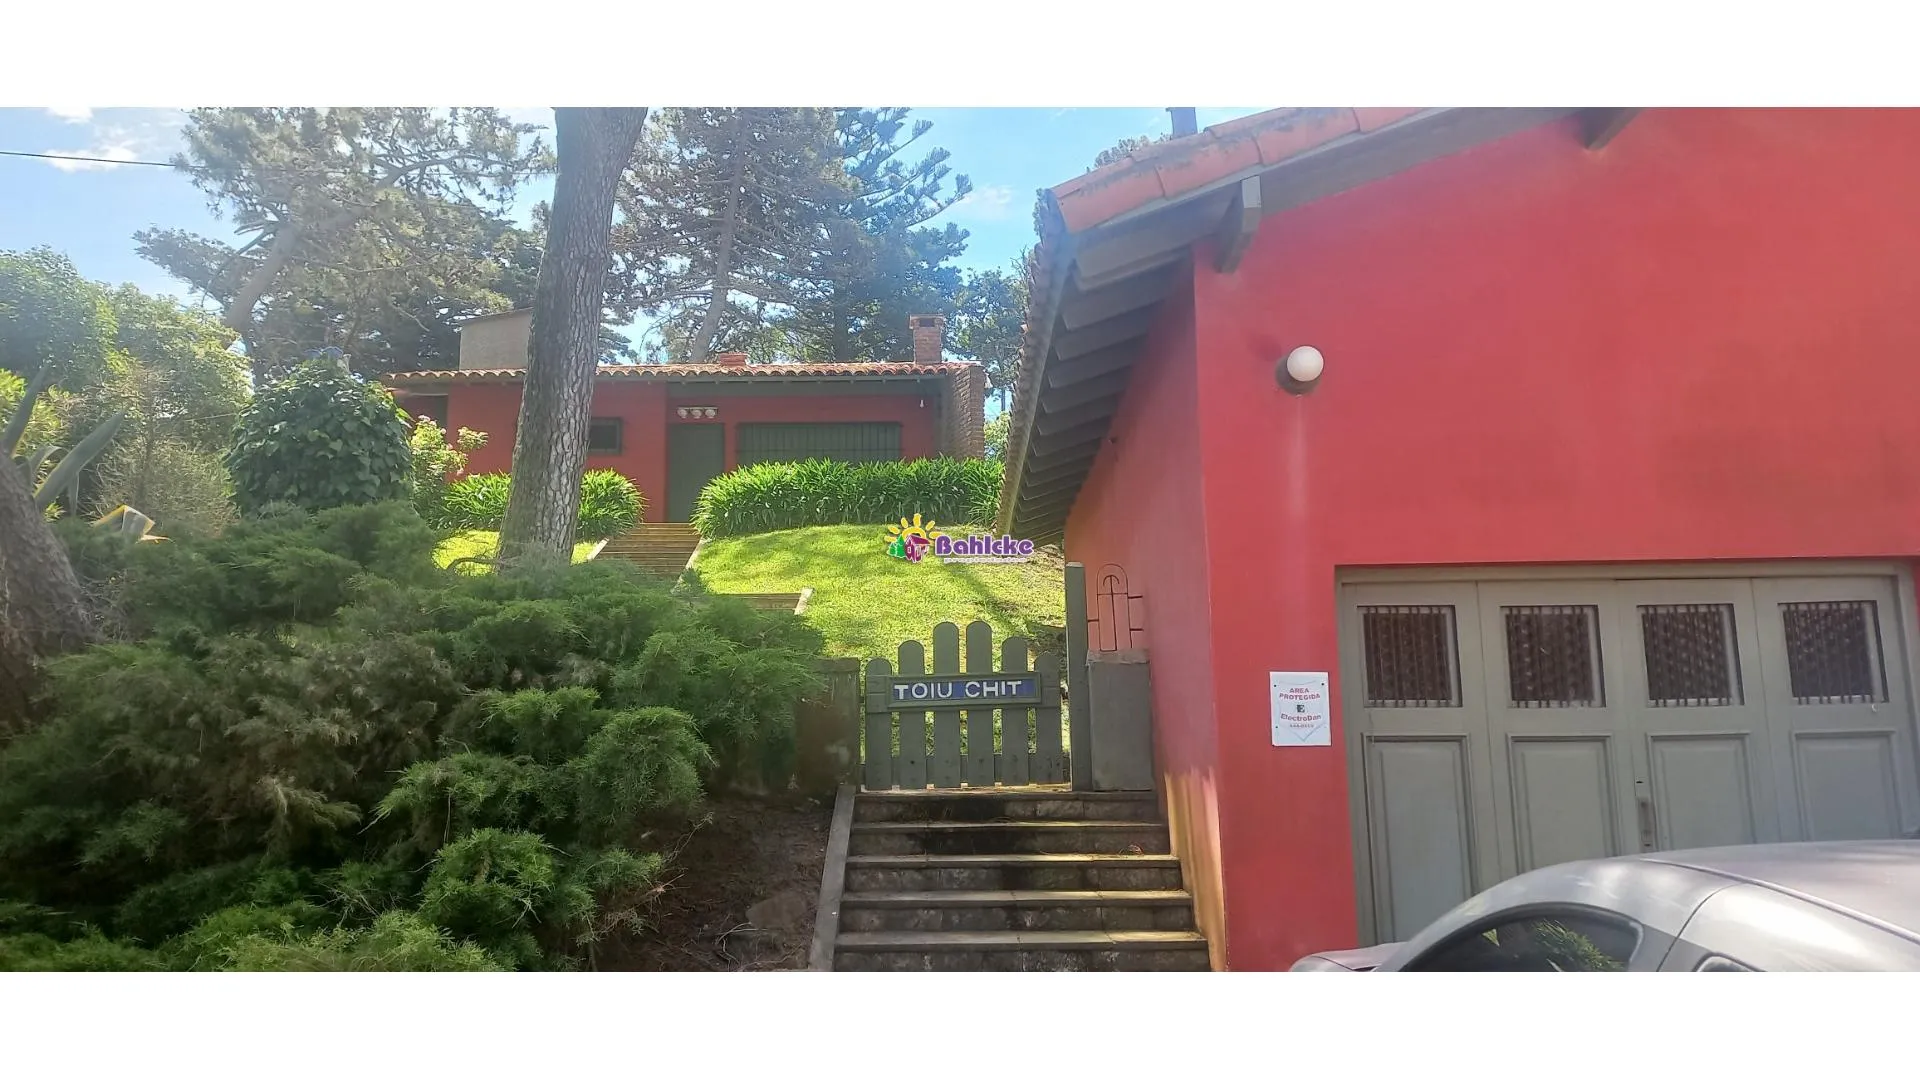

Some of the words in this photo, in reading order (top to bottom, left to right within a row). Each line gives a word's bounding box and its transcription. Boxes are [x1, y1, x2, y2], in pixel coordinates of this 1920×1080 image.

[894, 682, 953, 700] TOIU
[965, 680, 1022, 698] CHIT
[1279, 692, 1321, 700] PROTEGIDA
